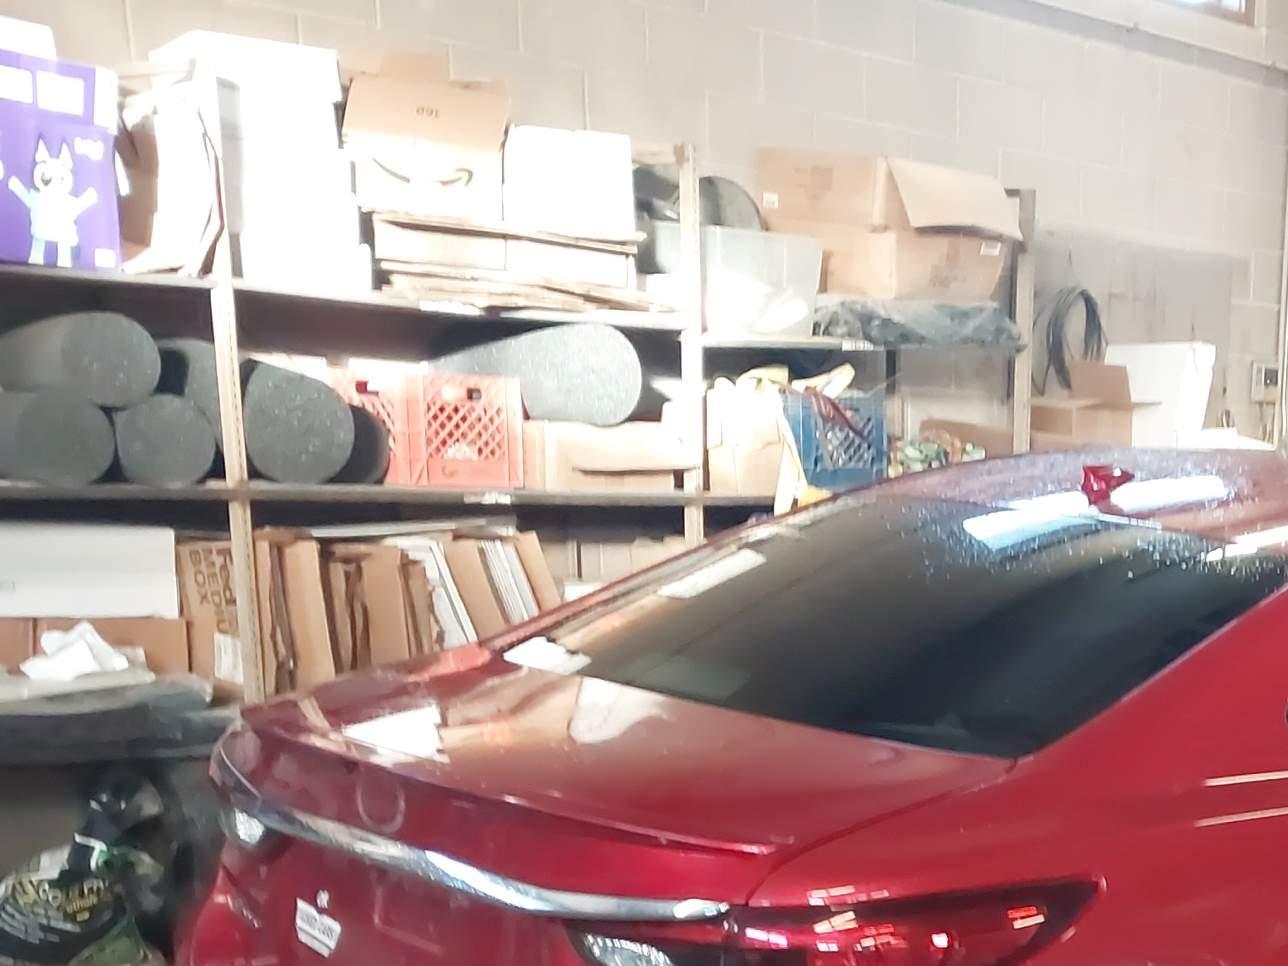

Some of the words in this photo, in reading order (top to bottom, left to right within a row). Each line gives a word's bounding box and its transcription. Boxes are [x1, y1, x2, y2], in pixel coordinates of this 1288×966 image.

[189, 550, 210, 605] BOX
[201, 547, 229, 633] MEDIU
[216, 547, 238, 611] Fed
